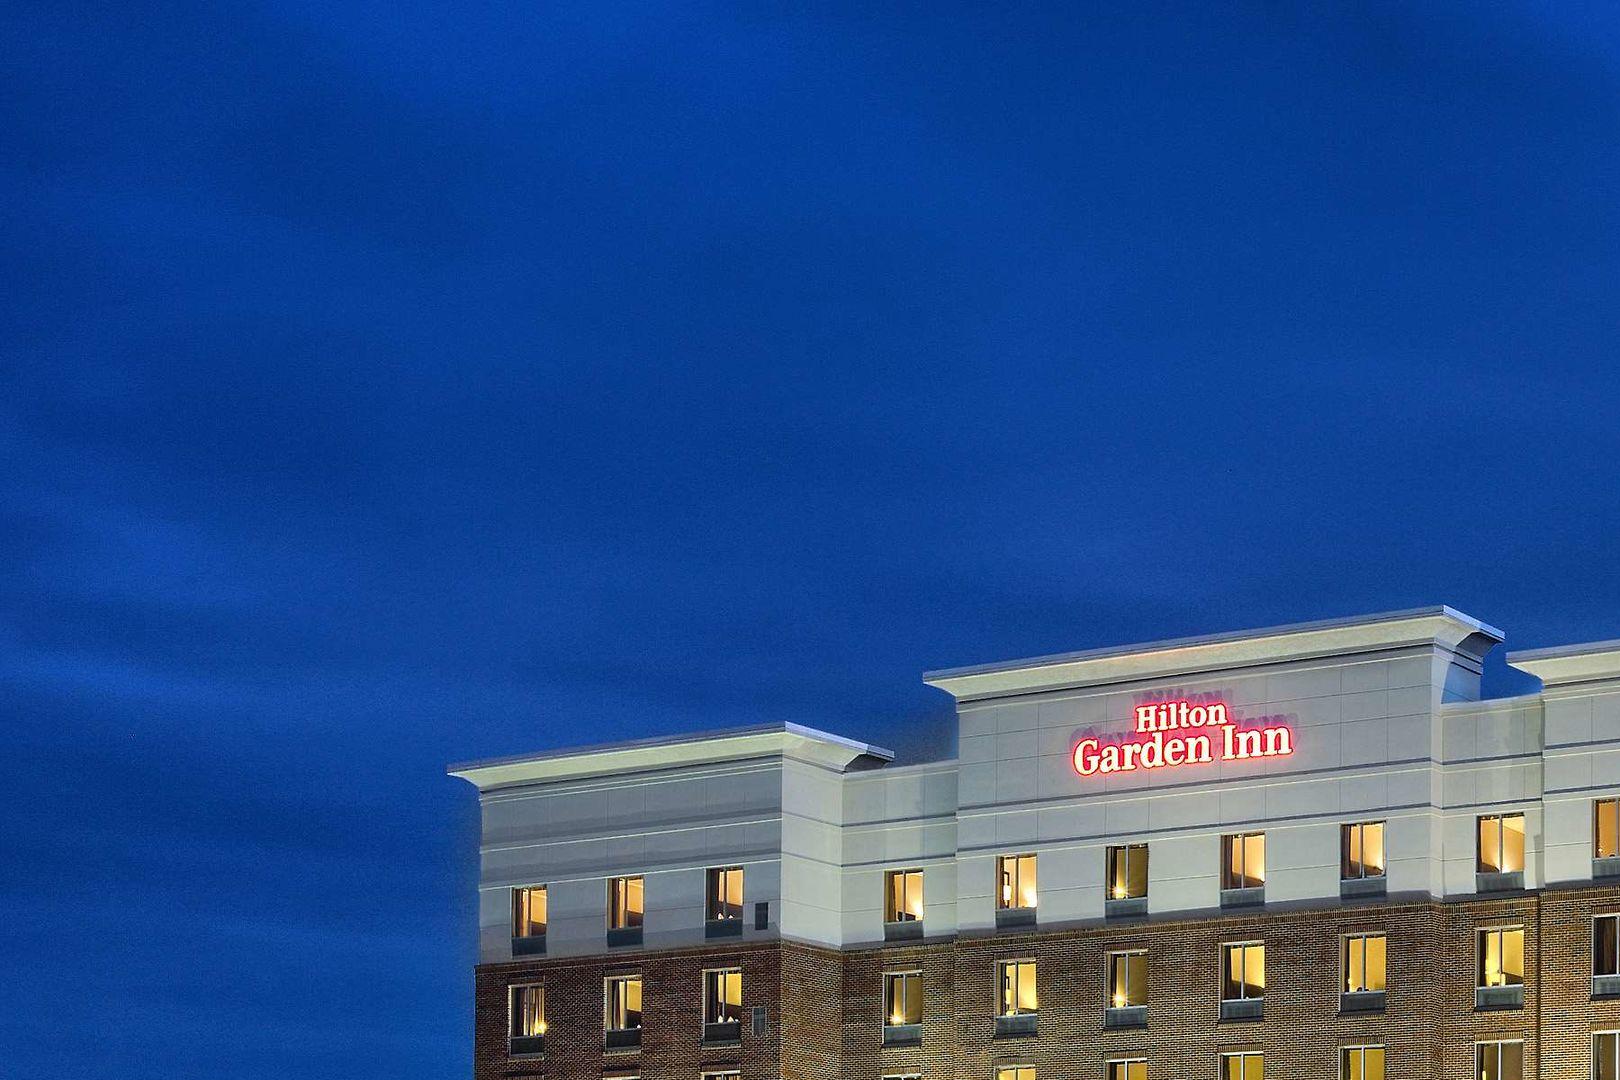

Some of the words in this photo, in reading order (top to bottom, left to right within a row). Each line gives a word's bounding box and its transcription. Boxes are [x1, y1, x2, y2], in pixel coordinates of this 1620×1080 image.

[1136, 702, 1228, 733] Hilton
[1074, 733, 1213, 775] Garden
[1220, 725, 1293, 760] Inn
